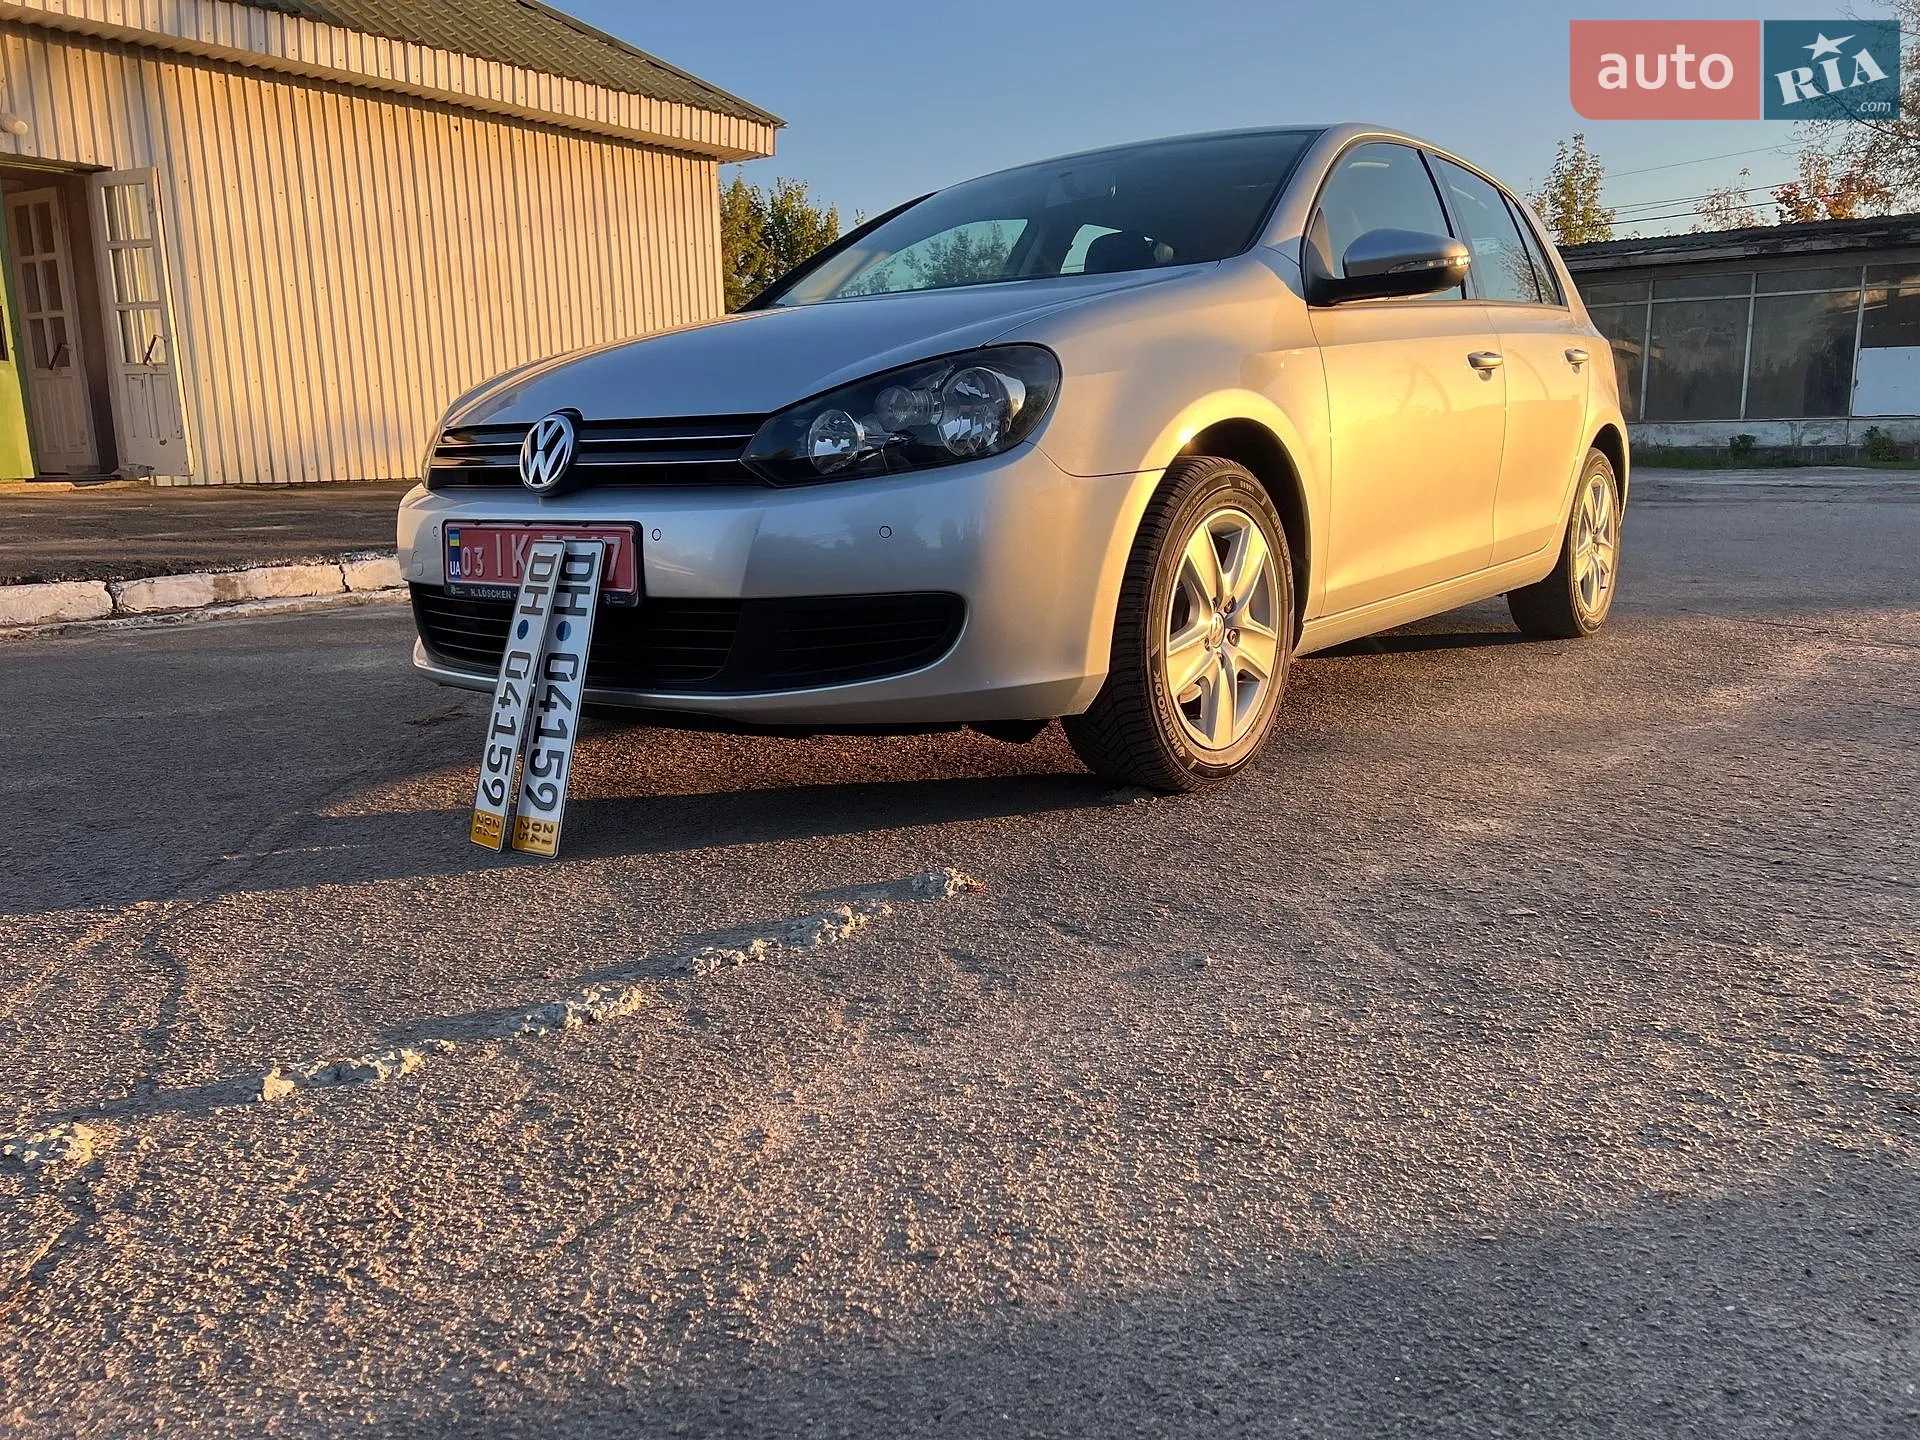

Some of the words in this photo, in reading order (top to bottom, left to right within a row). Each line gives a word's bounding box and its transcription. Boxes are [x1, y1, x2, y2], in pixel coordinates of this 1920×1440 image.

[449, 560, 462, 576] UA
[462, 546, 485, 578] 03
[519, 552, 558, 616] DH
[552, 552, 596, 617] DH
[482, 651, 532, 807] 04159
[525, 653, 579, 812] 04159
